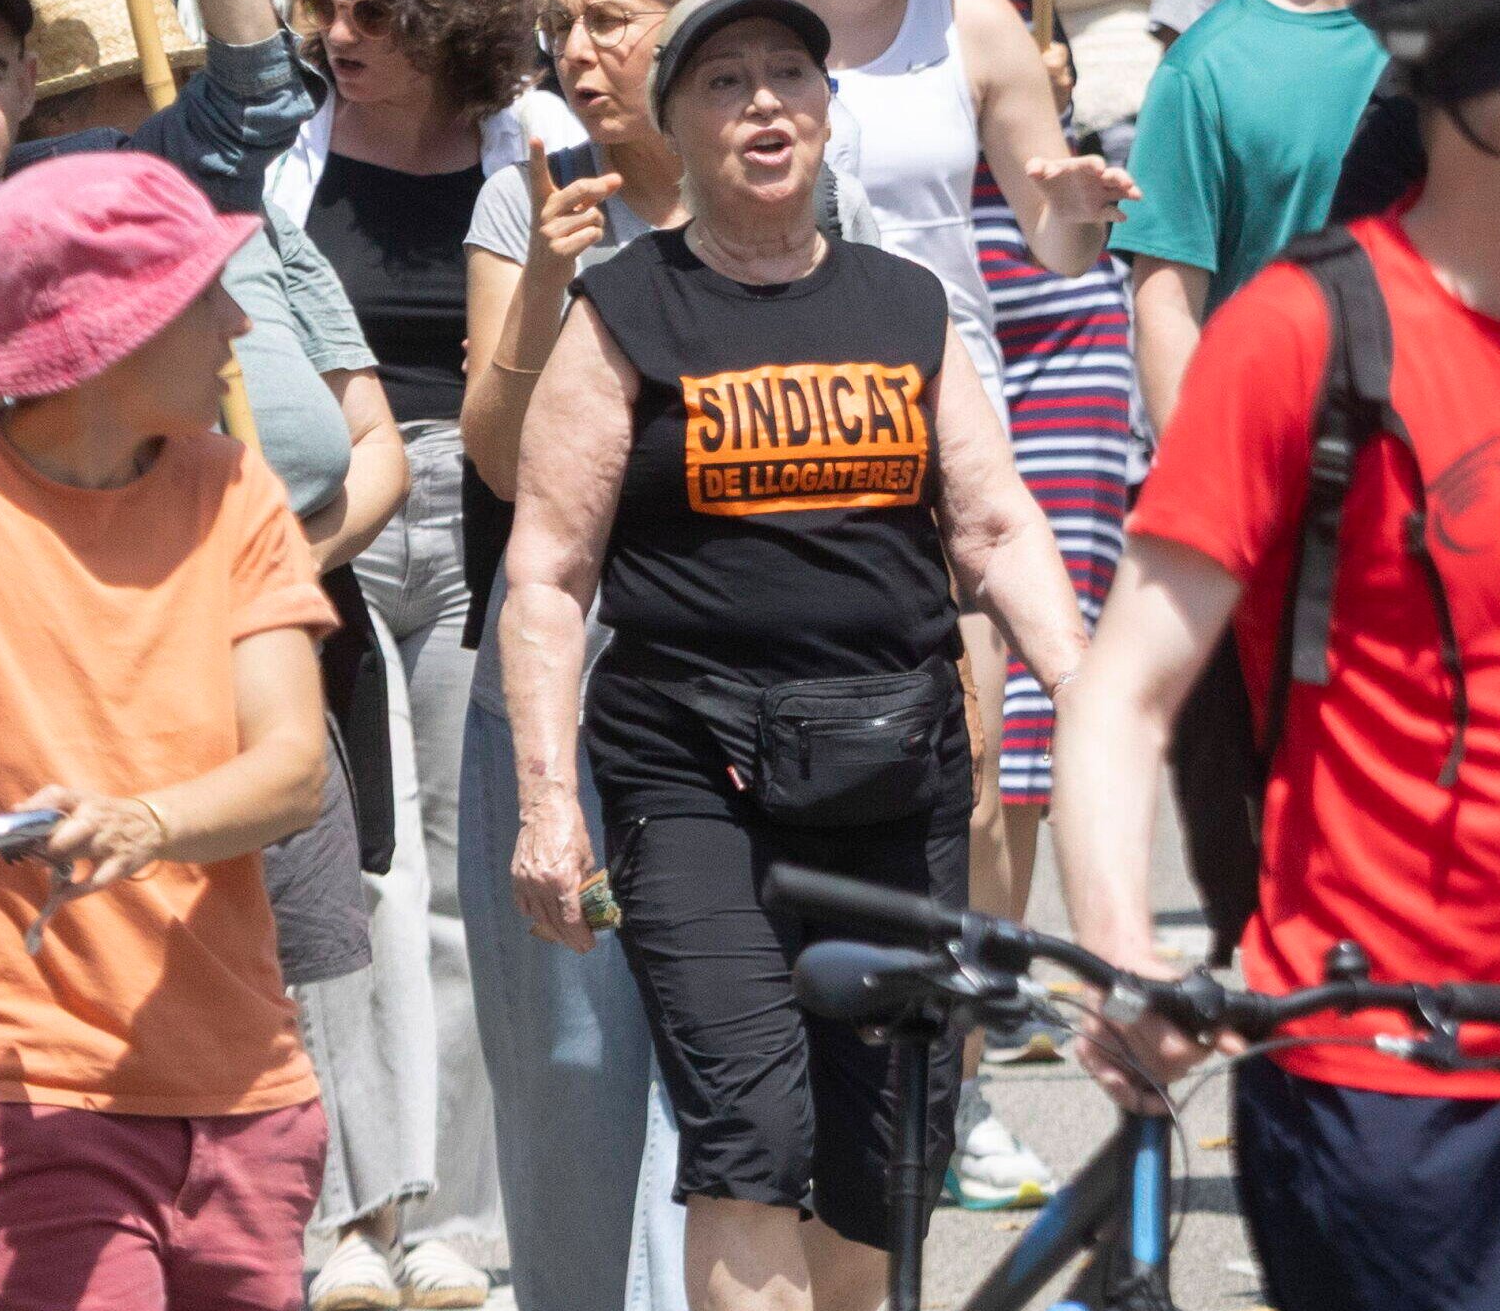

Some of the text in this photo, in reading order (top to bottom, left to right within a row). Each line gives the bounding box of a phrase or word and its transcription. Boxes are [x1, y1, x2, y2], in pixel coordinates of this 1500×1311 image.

[699, 374, 914, 453] SINDICAT
[706, 460, 914, 498] DE LLOGATERES
